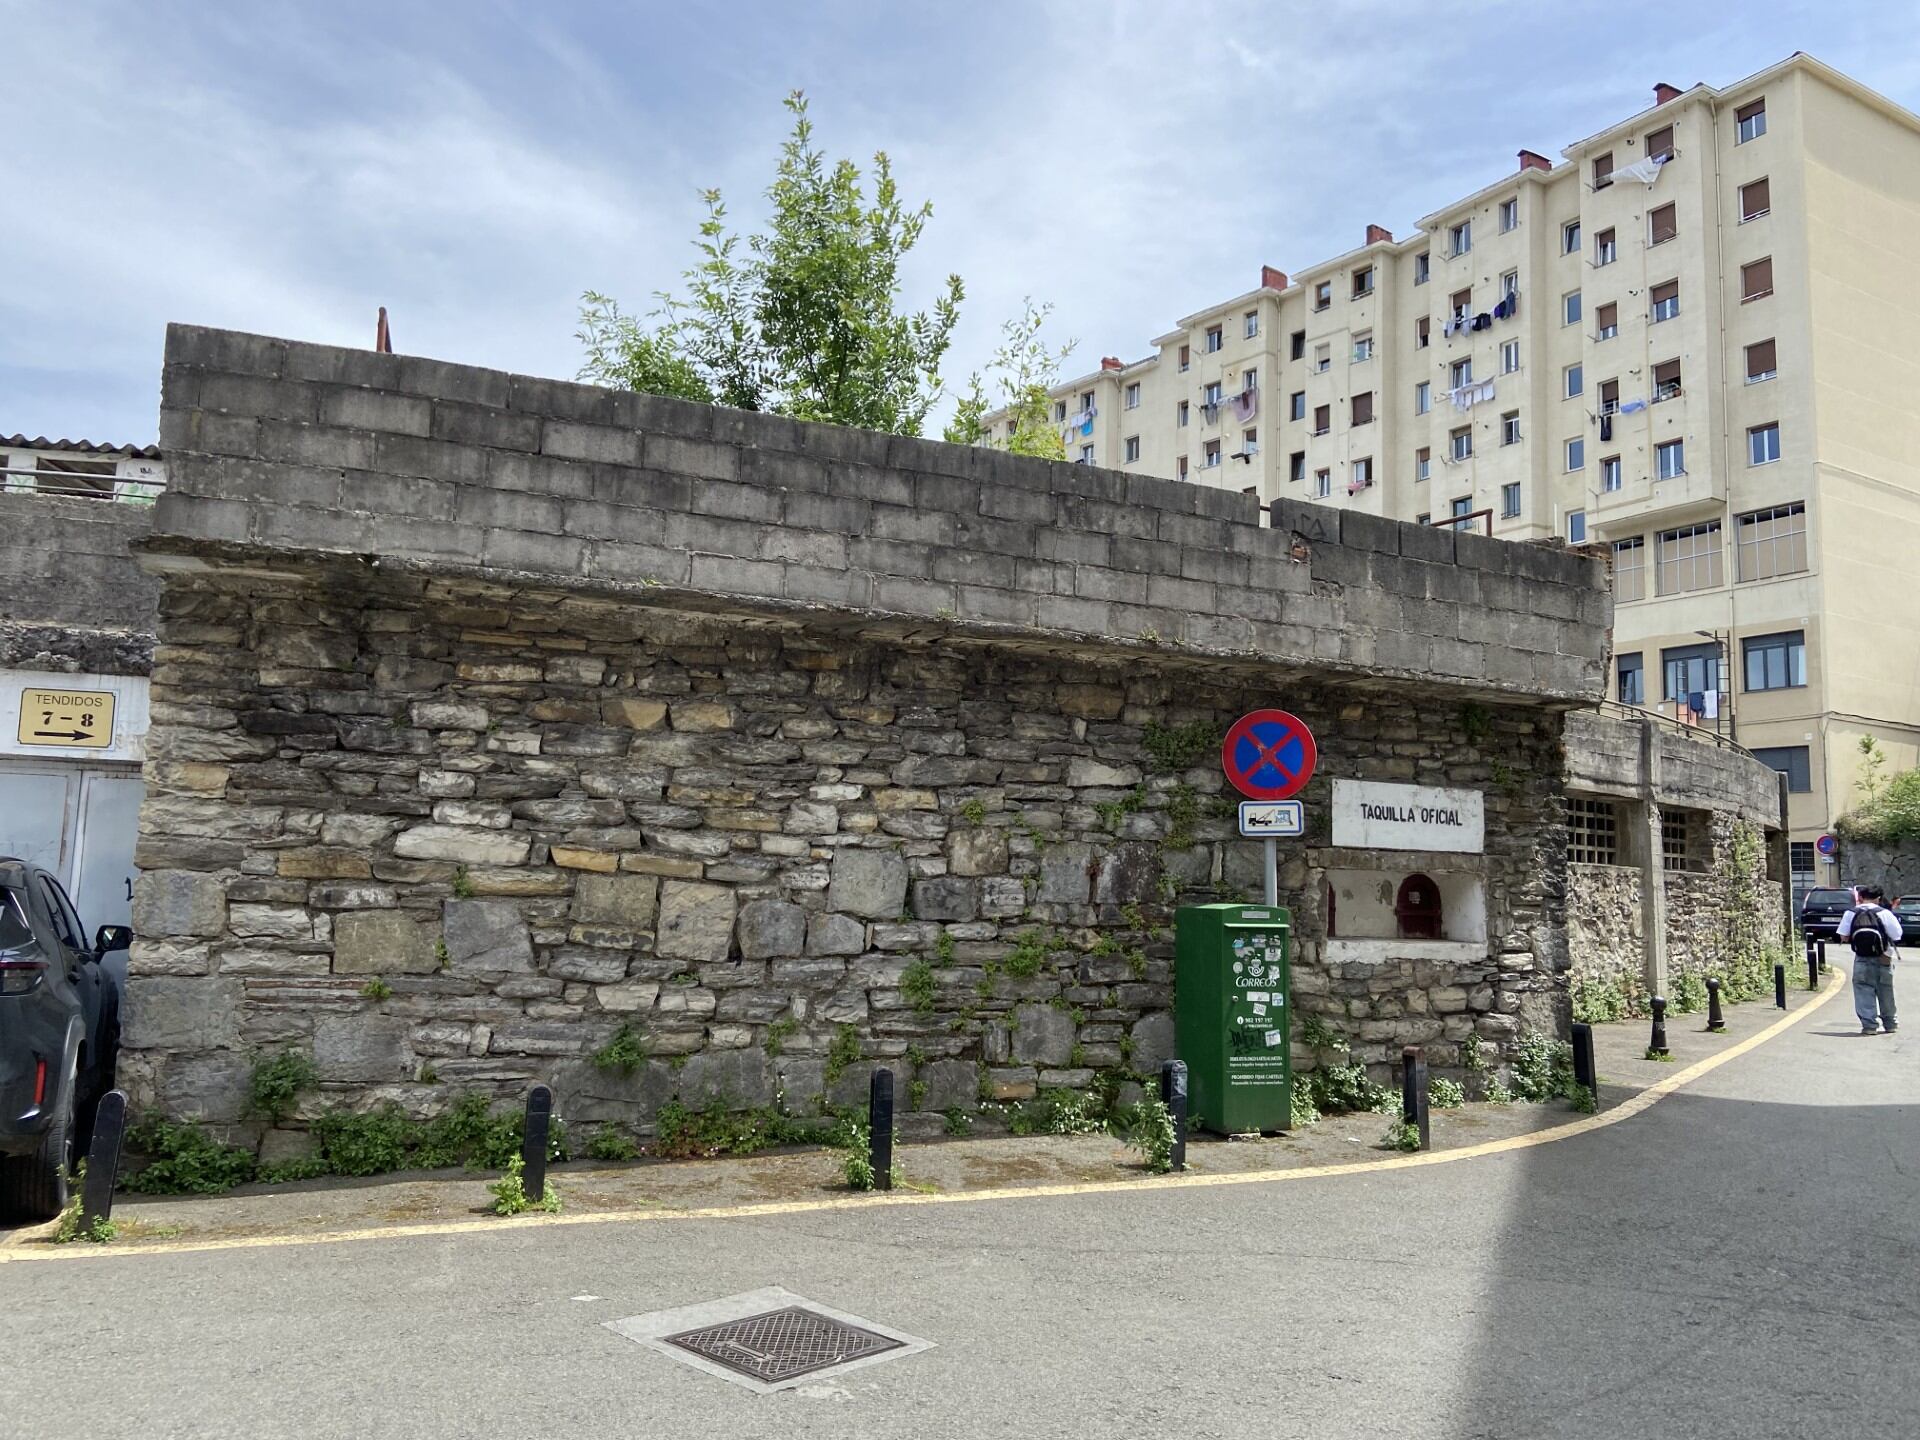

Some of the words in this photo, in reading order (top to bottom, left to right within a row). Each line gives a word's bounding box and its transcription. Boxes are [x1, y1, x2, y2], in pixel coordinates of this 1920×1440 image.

[35, 694, 103, 707] TENDIDOS
[42, 711, 54, 725] 7
[80, 713, 94, 727] 8
[1361, 803, 1415, 822] TAQUILLA
[1421, 808, 1462, 826] OFICIAL
